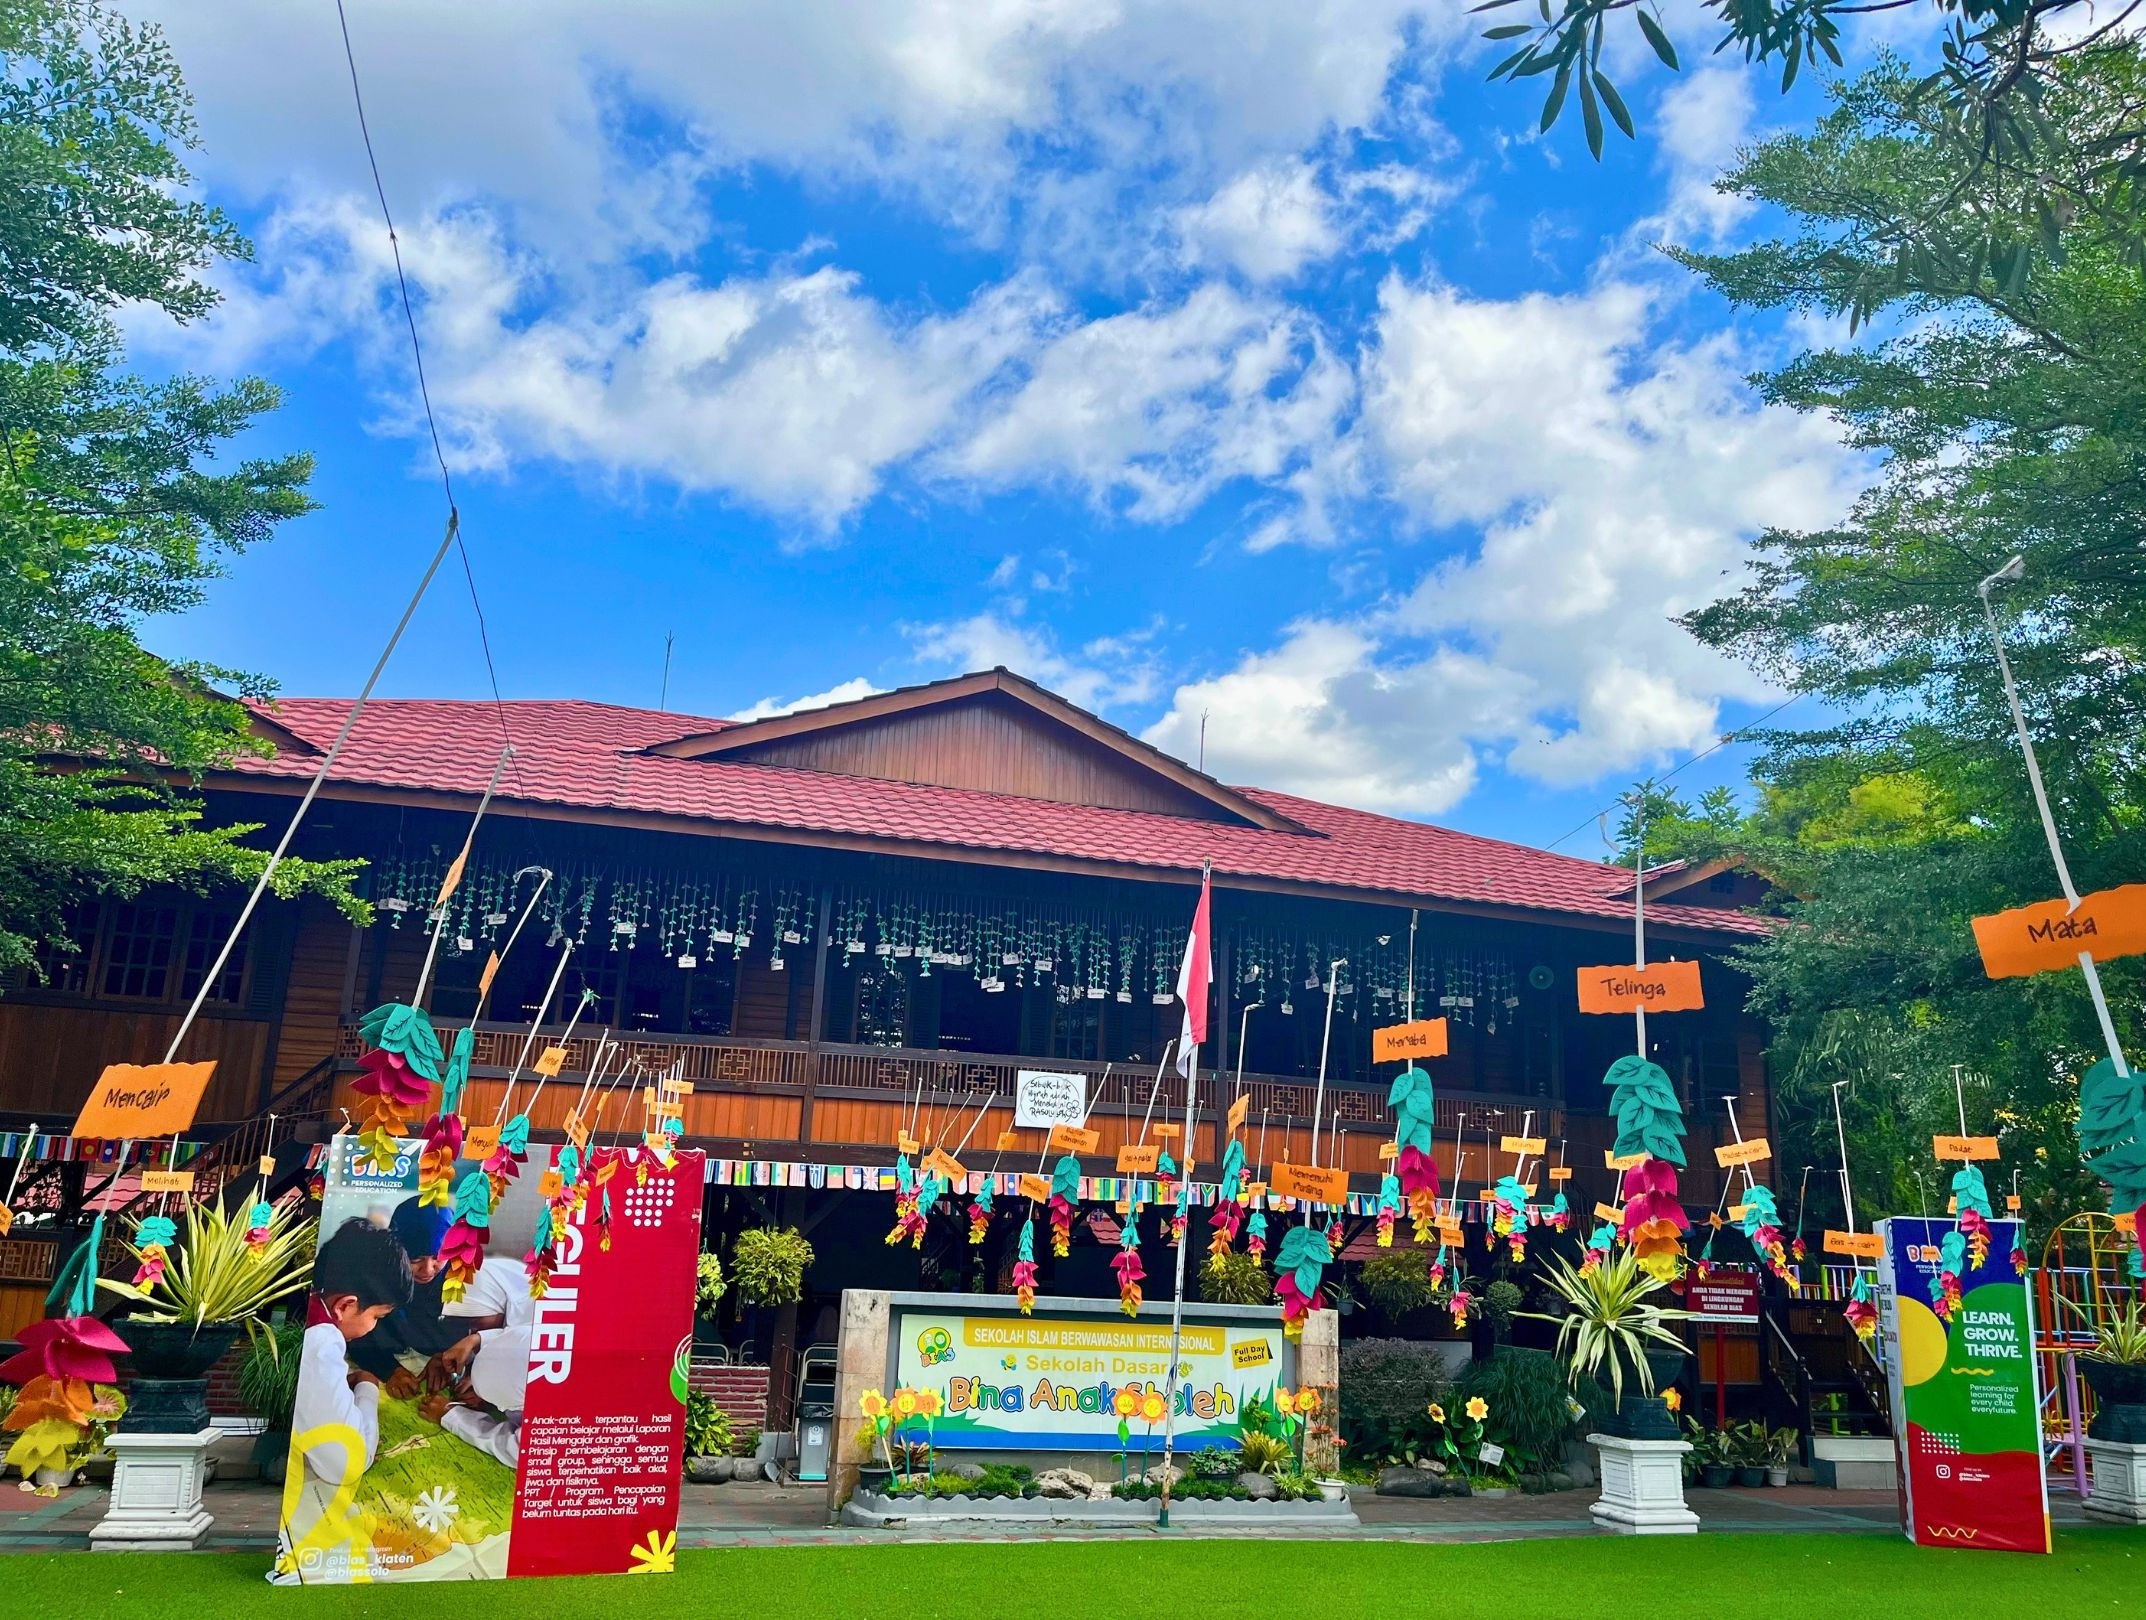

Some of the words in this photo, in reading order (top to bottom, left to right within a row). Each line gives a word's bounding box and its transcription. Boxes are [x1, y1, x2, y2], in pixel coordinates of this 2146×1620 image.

[2028, 917, 2097, 943] Mata
[1600, 977, 1666, 999] Telinga
[351, 1180, 403, 1188] PERSONALIZED
[1962, 1311, 2015, 1325] LEARN.
[974, 1328, 1024, 1343] SEKOLAH
[1027, 1330, 1058, 1345] ISLAM
[1061, 1331, 1133, 1348] BERWAWASAN
[1136, 1334, 1215, 1350] INTERNSIONAL
[1964, 1327, 2019, 1342] GROW.
[1234, 1347, 1249, 1356] Full
[1250, 1345, 1265, 1354] Day
[1964, 1343, 2023, 1358] THRIVE.
[920, 1347, 955, 1367] BIAS
[1238, 1351, 1265, 1363] School
[1026, 1355, 1105, 1373] Sekolah
[1113, 1358, 1168, 1375] Dasar
[1970, 1383, 2019, 1392] Personalized
[949, 1376, 1024, 1412] Bina
[1030, 1377, 1117, 1416] Anak
[1970, 1391, 2002, 1400] learning
[532, 1416, 581, 1424] Anak-anak
[596, 1415, 638, 1425] terpantau
[652, 1414, 671, 1422] hasil
[531, 1426, 568, 1437] capaian
[570, 1425, 600, 1436] belajar
[602, 1425, 634, 1433] melalui
[636, 1425, 670, 1435] Laporan
[530, 1436, 551, 1445] Hasil
[552, 1435, 594, 1446] Mengajar
[595, 1435, 612, 1443] dan
[529, 1447, 557, 1457] Prinsip
[565, 1445, 627, 1457] pembelajaran
[635, 1445, 669, 1455] dengan
[528, 1457, 552, 1466] small
[592, 1455, 632, 1466] sehingga
[638, 1455, 668, 1463] semua
[527, 1468, 551, 1476] siswa
[559, 1465, 616, 1478] terperhatikan
[623, 1465, 641, 1473] baik
[546, 1477, 564, 1486] dan
[525, 1488, 540, 1497] PPT
[565, 1487, 604, 1498] Program
[614, 1484, 666, 1496] Pencapaian
[524, 1498, 552, 1509] Target
[558, 1497, 583, 1506] untuk
[588, 1497, 612, 1505] siswa
[618, 1495, 638, 1506] bagi
[643, 1495, 665, 1506] yang
[522, 1509, 551, 1518] belum
[553, 1508, 581, 1517] tuntas
[582, 1506, 606, 1518] pada
[608, 1506, 625, 1515] hari
